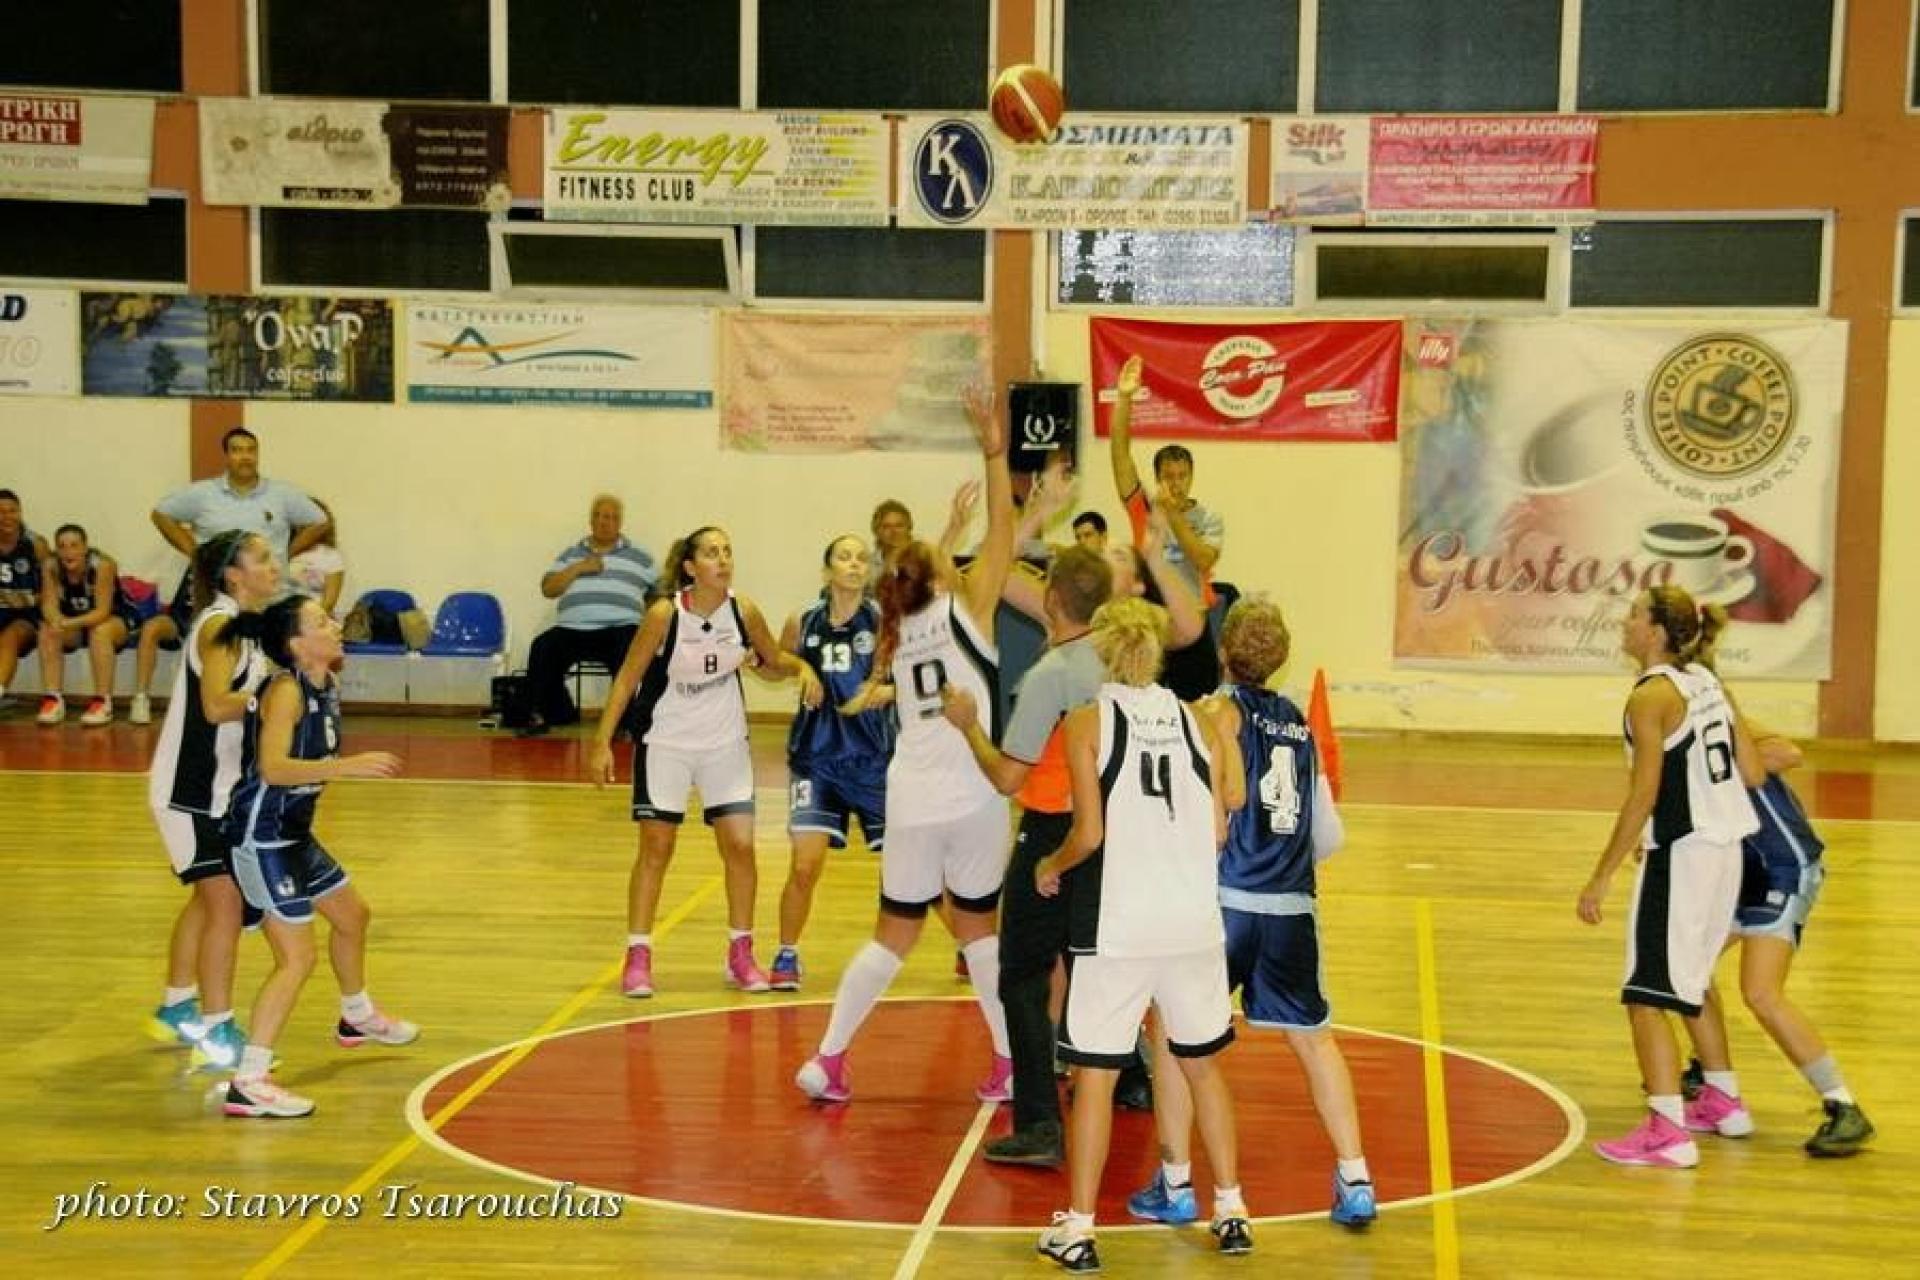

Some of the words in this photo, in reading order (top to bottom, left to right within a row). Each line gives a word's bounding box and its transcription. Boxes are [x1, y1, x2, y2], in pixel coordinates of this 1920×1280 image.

[558, 112, 769, 188] Energy
[1042, 125, 1234, 146] ΟΣΜΗΜΑΤΑ
[560, 177, 636, 202] FITNESS
[648, 178, 695, 202] CLUB
[1657, 347, 1709, 402] POINT
[1726, 347, 1785, 400] COFFEE
[1655, 412, 1714, 466] COFFEE
[1731, 410, 1784, 466] POINT
[703, 654, 718, 675] 8
[821, 643, 851, 672] 13
[1702, 719, 1732, 784] 6
[1139, 750, 1176, 823] 4
[1259, 744, 1300, 835] 4
